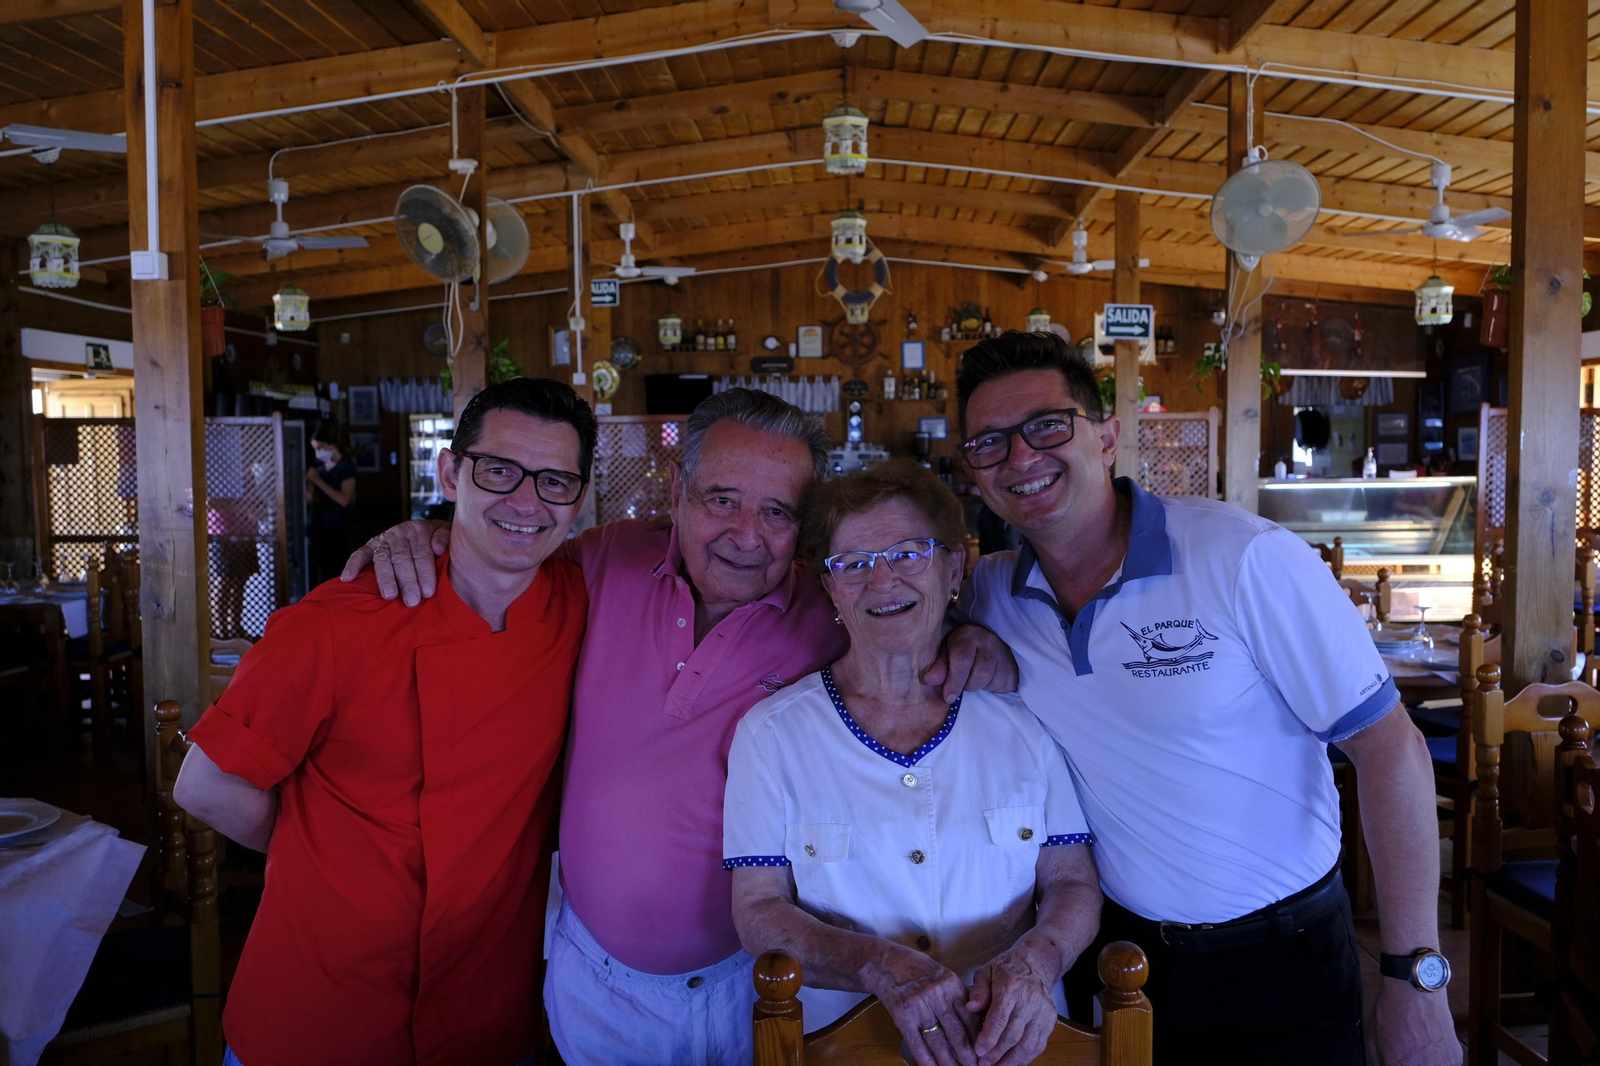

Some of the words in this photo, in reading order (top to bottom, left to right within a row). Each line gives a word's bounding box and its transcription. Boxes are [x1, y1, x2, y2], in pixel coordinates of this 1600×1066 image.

[591, 282, 616, 294] ALIDA
[1107, 308, 1149, 324] SALIDA
[1141, 626, 1153, 636] EL
[1155, 619, 1194, 631] PARQUE
[1131, 661, 1210, 678] RESTAURANTE
